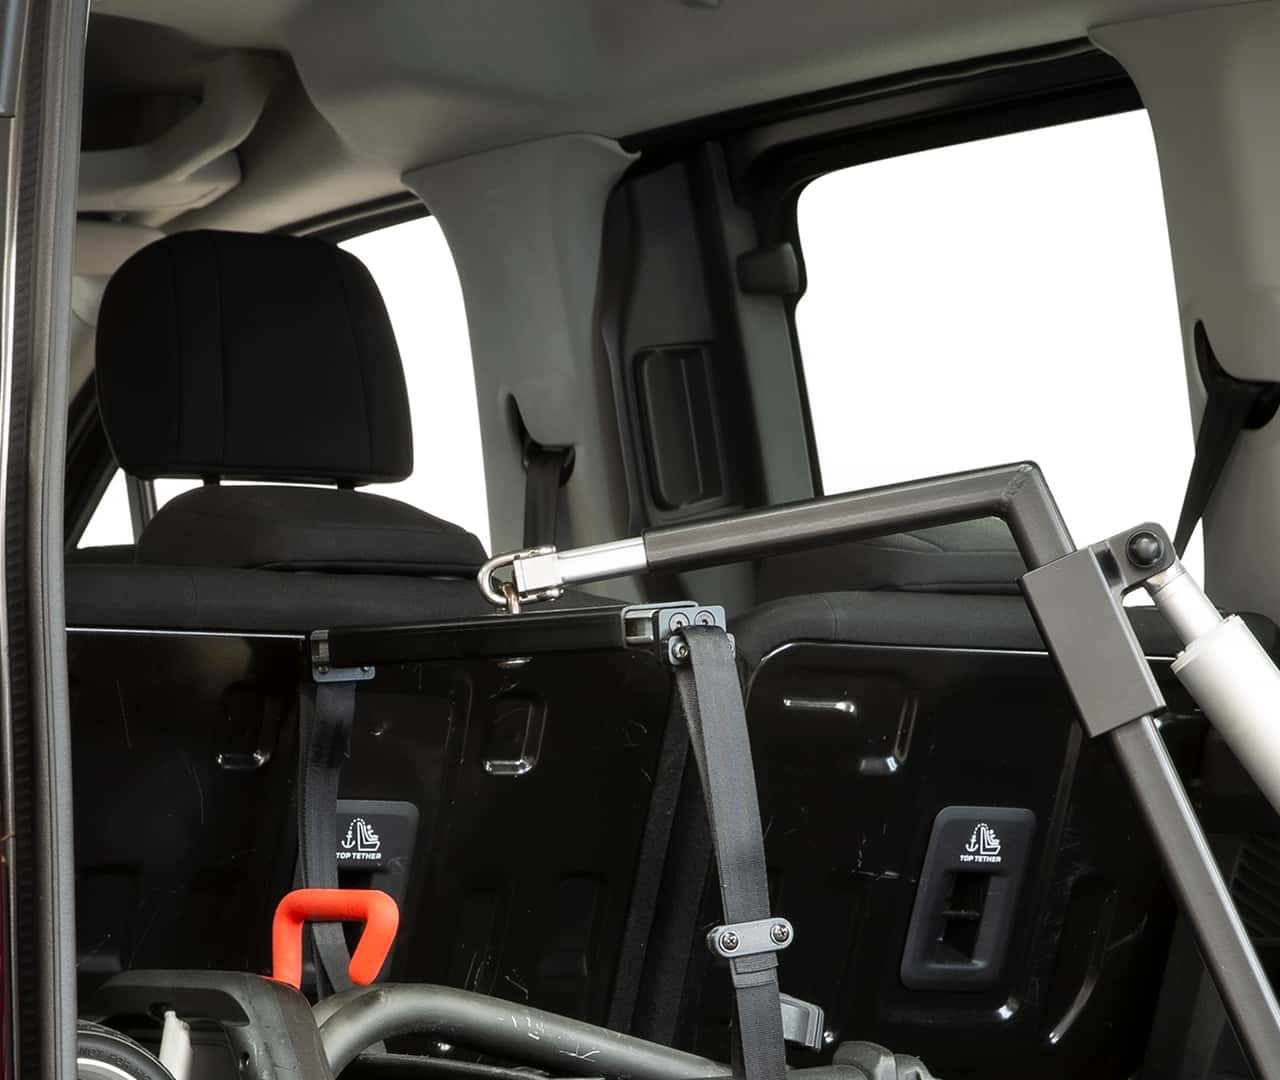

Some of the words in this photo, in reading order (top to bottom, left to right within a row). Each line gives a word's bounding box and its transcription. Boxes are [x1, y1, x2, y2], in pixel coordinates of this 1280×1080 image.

[352, 852, 381, 860] TETHER
[960, 854, 974, 862] TOP
[975, 855, 1002, 863] TETHER
